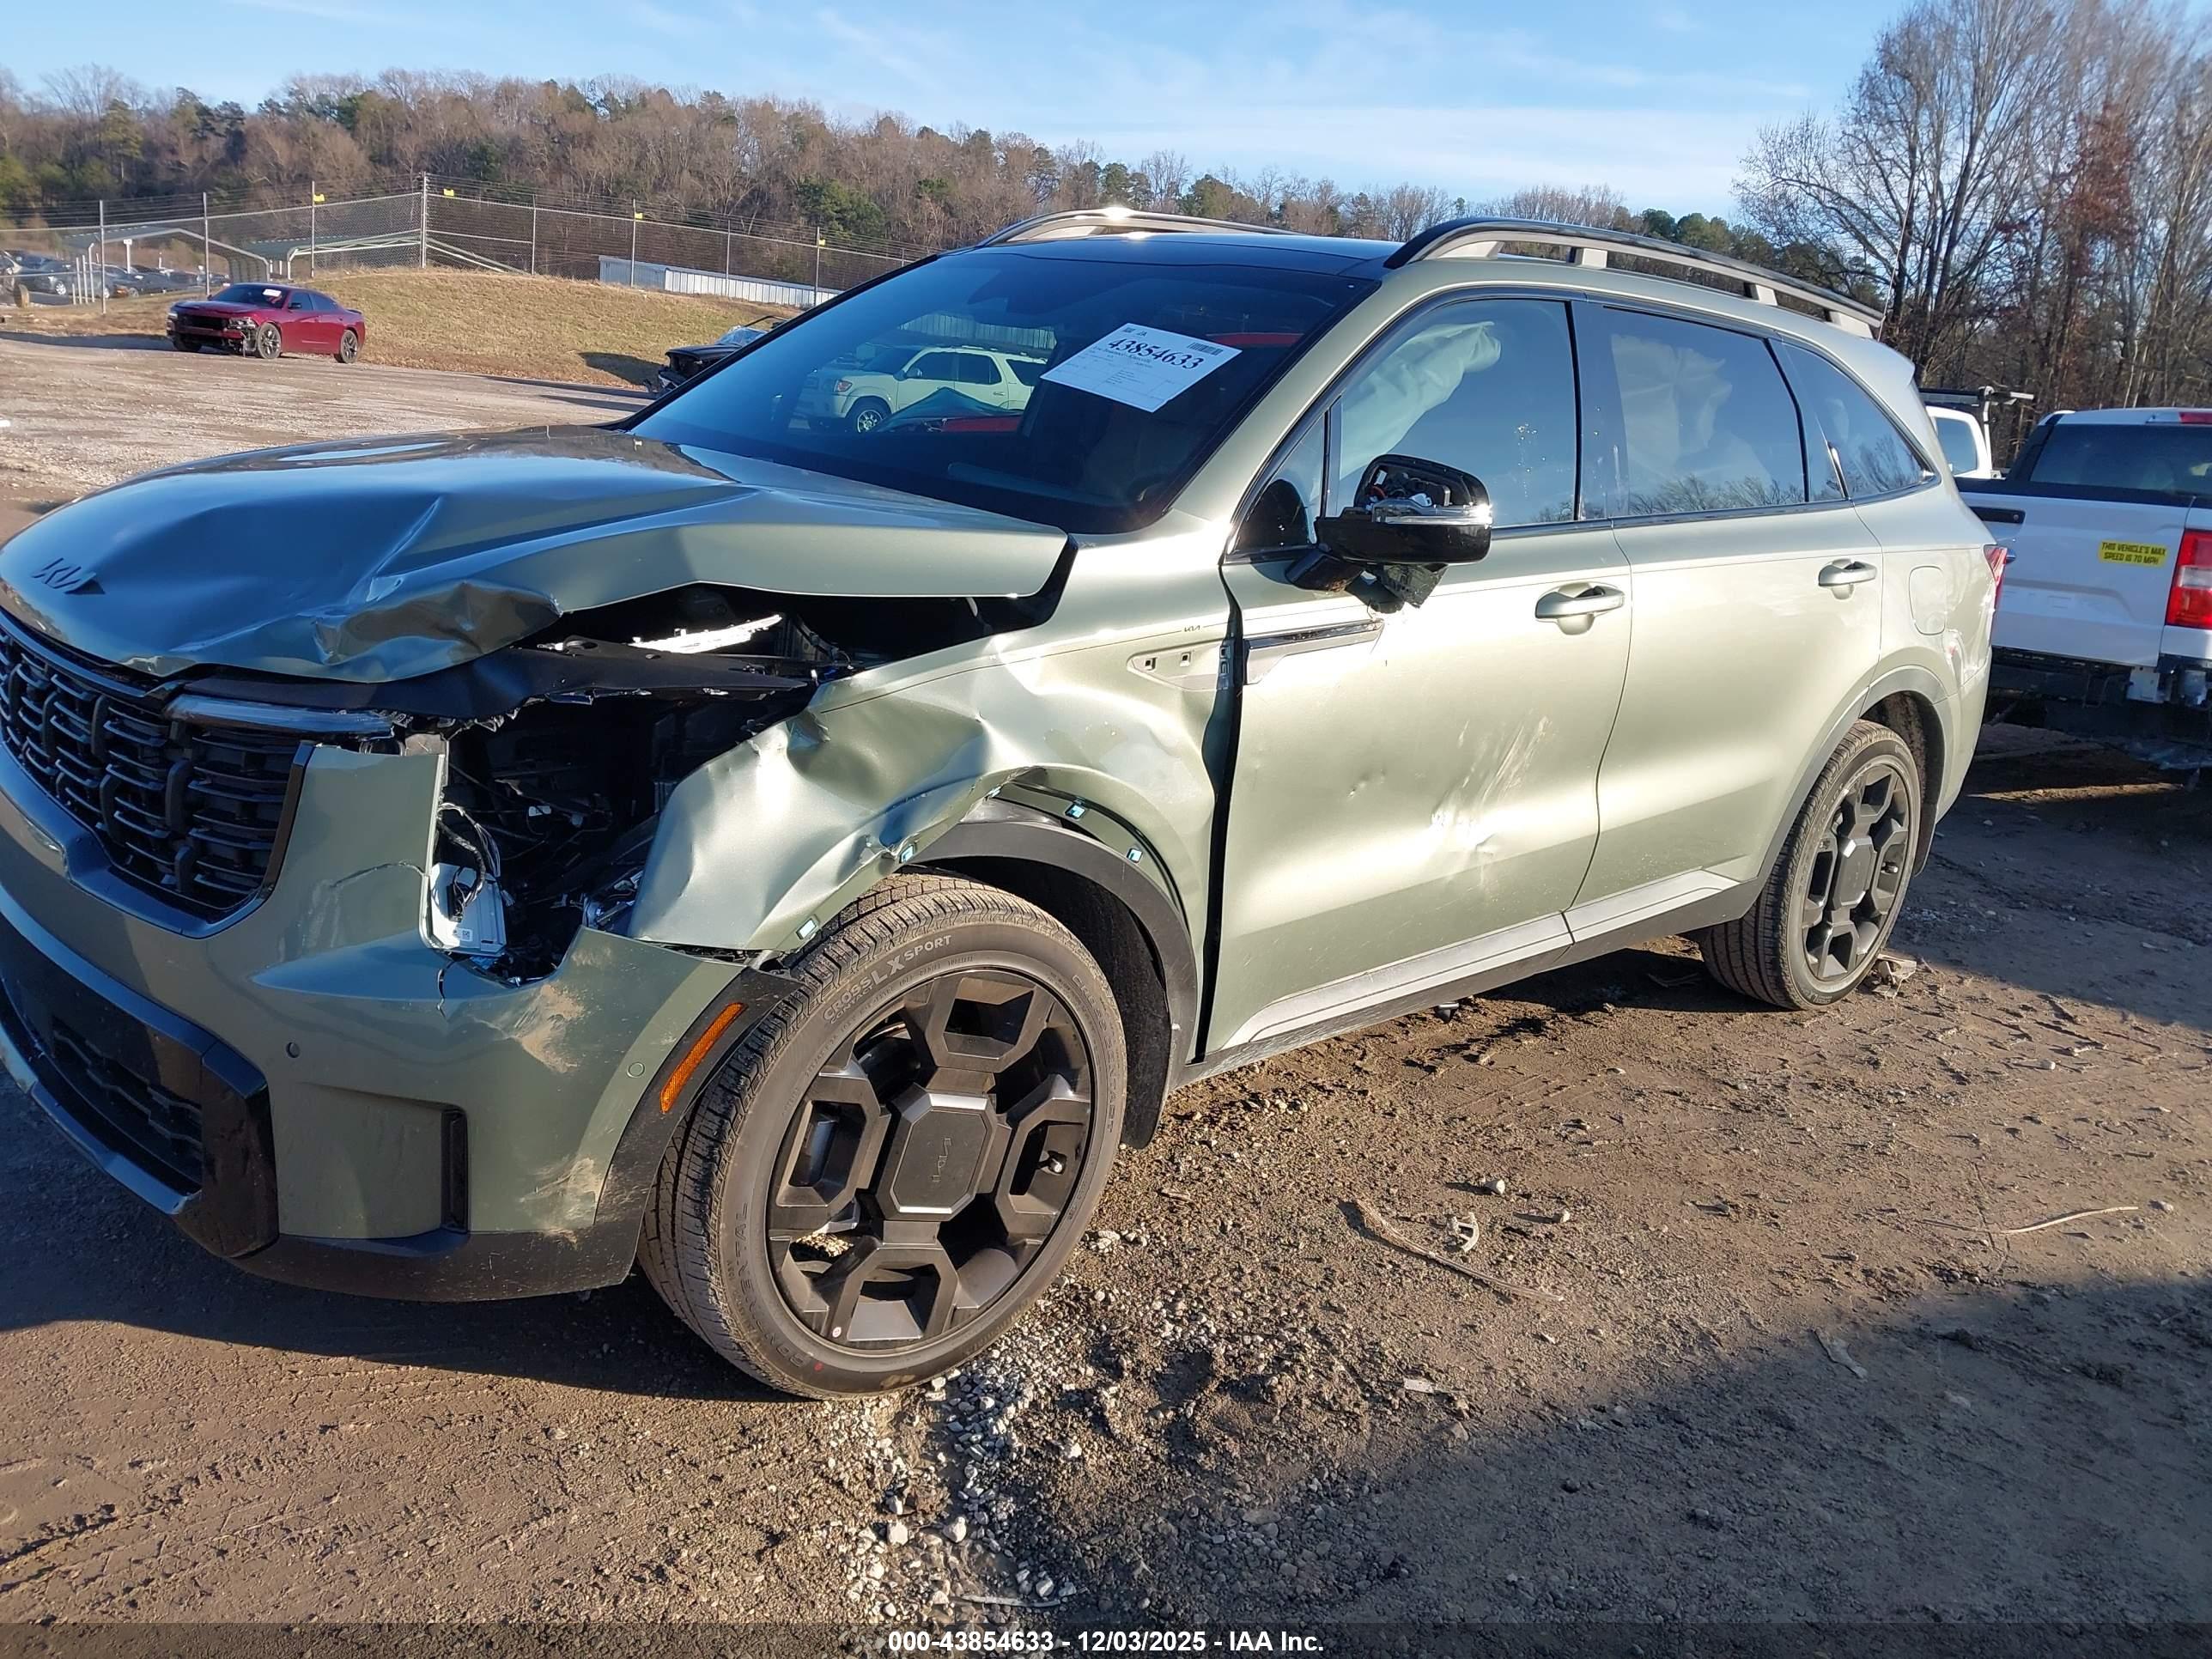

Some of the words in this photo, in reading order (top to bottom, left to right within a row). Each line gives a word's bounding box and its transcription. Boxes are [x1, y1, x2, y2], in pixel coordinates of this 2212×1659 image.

[1108, 338, 1205, 369] 43854633
[2102, 542, 2117, 550] THIS
[2118, 544, 2150, 554] VEHICLE'S
[2151, 546, 2166, 556] MAX
[2103, 551, 2124, 561] SPEED
[2125, 553, 2132, 562] IS
[2143, 556, 2160, 565] MPH
[823, 975, 872, 1021] CROSS
[903, 934, 952, 962] SPORT
